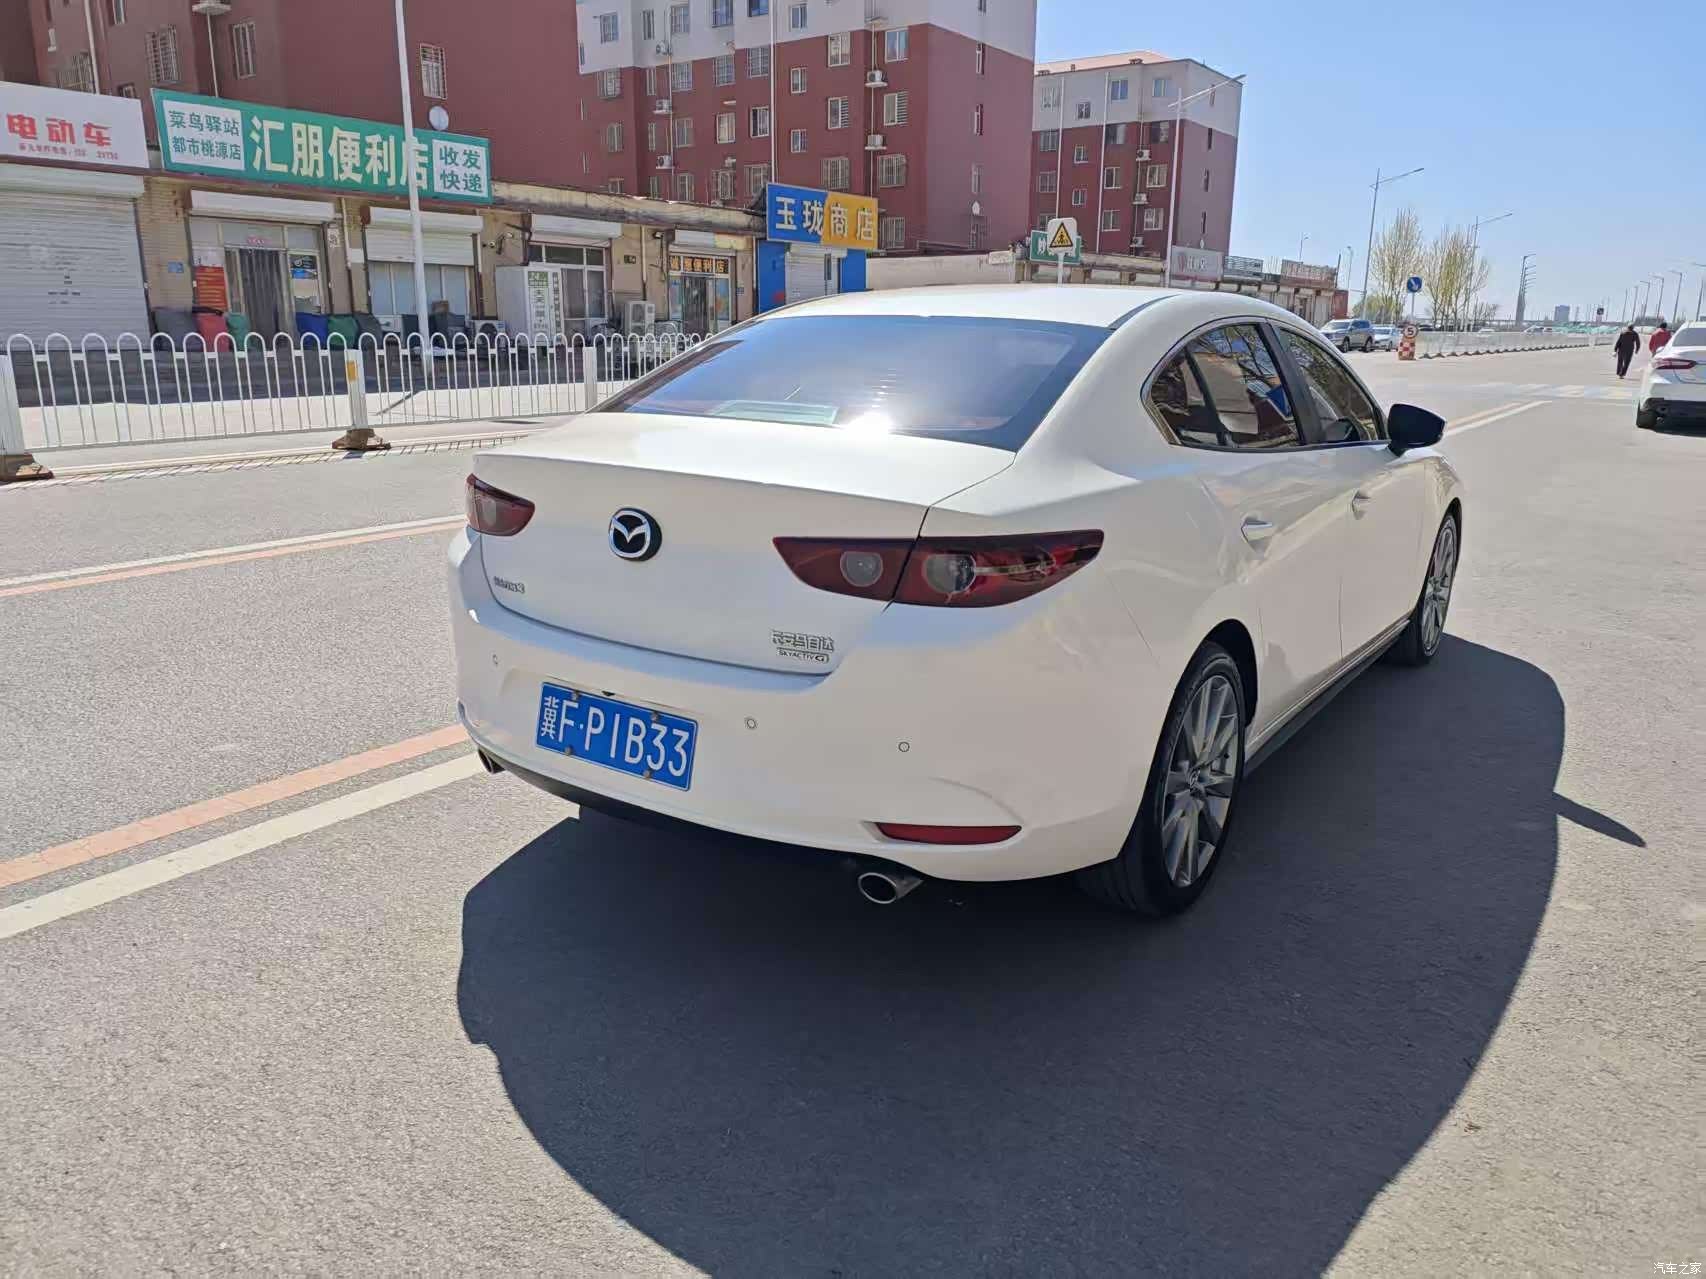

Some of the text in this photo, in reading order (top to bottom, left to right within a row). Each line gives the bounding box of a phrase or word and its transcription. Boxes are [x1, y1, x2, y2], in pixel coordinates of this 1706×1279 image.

[6, 113, 112, 147] 电动车
[168, 110, 240, 137] 菜鸟驿站
[171, 135, 242, 161] 都市桃源店
[249, 115, 429, 191] 汇朋便利店
[439, 145, 482, 170] 收发
[439, 169, 484, 194] 快递
[775, 196, 874, 241] 玉珑商店
[1407, 327, 1414, 336] 5
